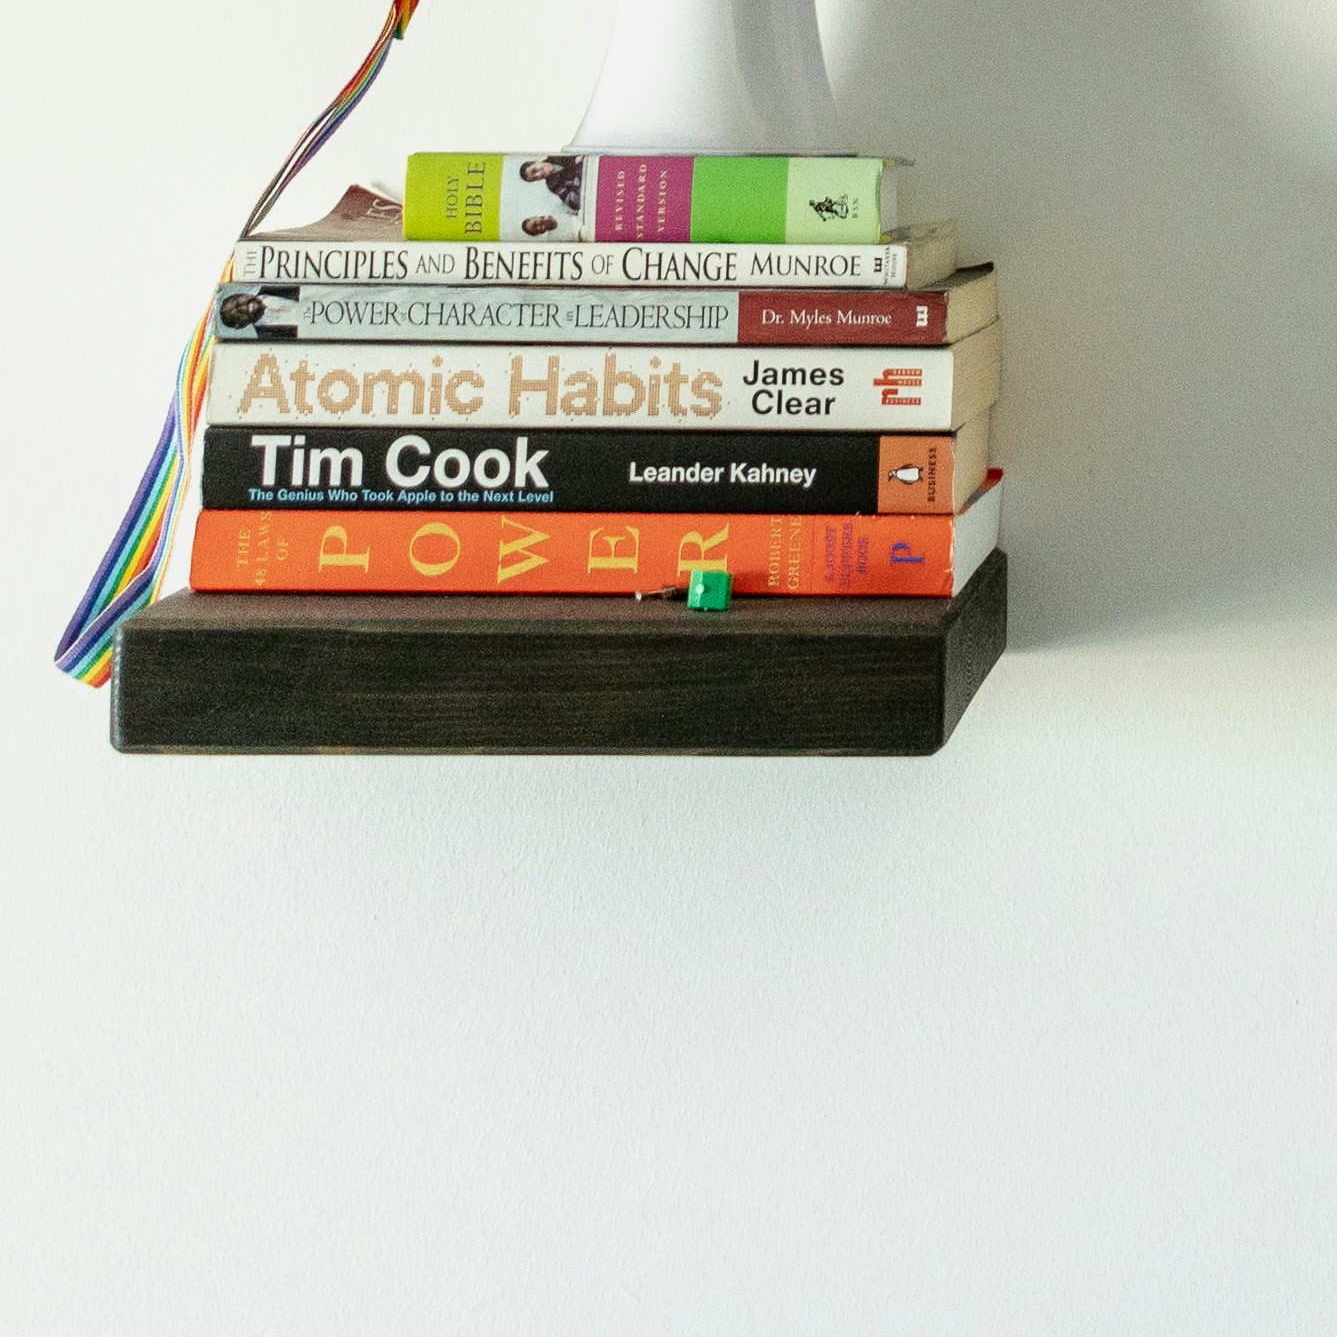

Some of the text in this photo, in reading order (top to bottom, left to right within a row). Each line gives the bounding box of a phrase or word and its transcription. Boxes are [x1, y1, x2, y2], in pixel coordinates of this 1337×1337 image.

[446, 176, 459, 219] HOLY
[465, 161, 486, 234] BIBLE
[615, 170, 626, 231] REVISED
[636, 164, 647, 239] STANDARD
[657, 170, 668, 233] VERSION
[243, 245, 737, 281] THE PRINCIPLES AND BENEFITS OF CHANGE
[750, 252, 861, 276] MUNROE
[310, 300, 400, 325] POWER
[407, 301, 562, 328] CHARACTER
[575, 303, 729, 329] LEADERSHIP
[761, 309, 892, 329] Dr. Myles Munroe
[237, 352, 723, 417] Atomic Habits
[743, 359, 845, 386] James
[751, 389, 836, 416] Clear
[251, 434, 549, 488] Tim Cook
[629, 462, 817, 488] Leander Kahney
[927, 447, 937, 503] BUSINESS
[249, 488, 554, 505] The Genius Who Took Apple to the Next Level
[235, 529, 251, 568] THE
[256, 510, 273, 563] LAWS
[276, 536, 290, 561] OF
[768, 516, 783, 588] ROBERT
[787, 515, 802, 590] GREENE
[890, 541, 925, 565] P
